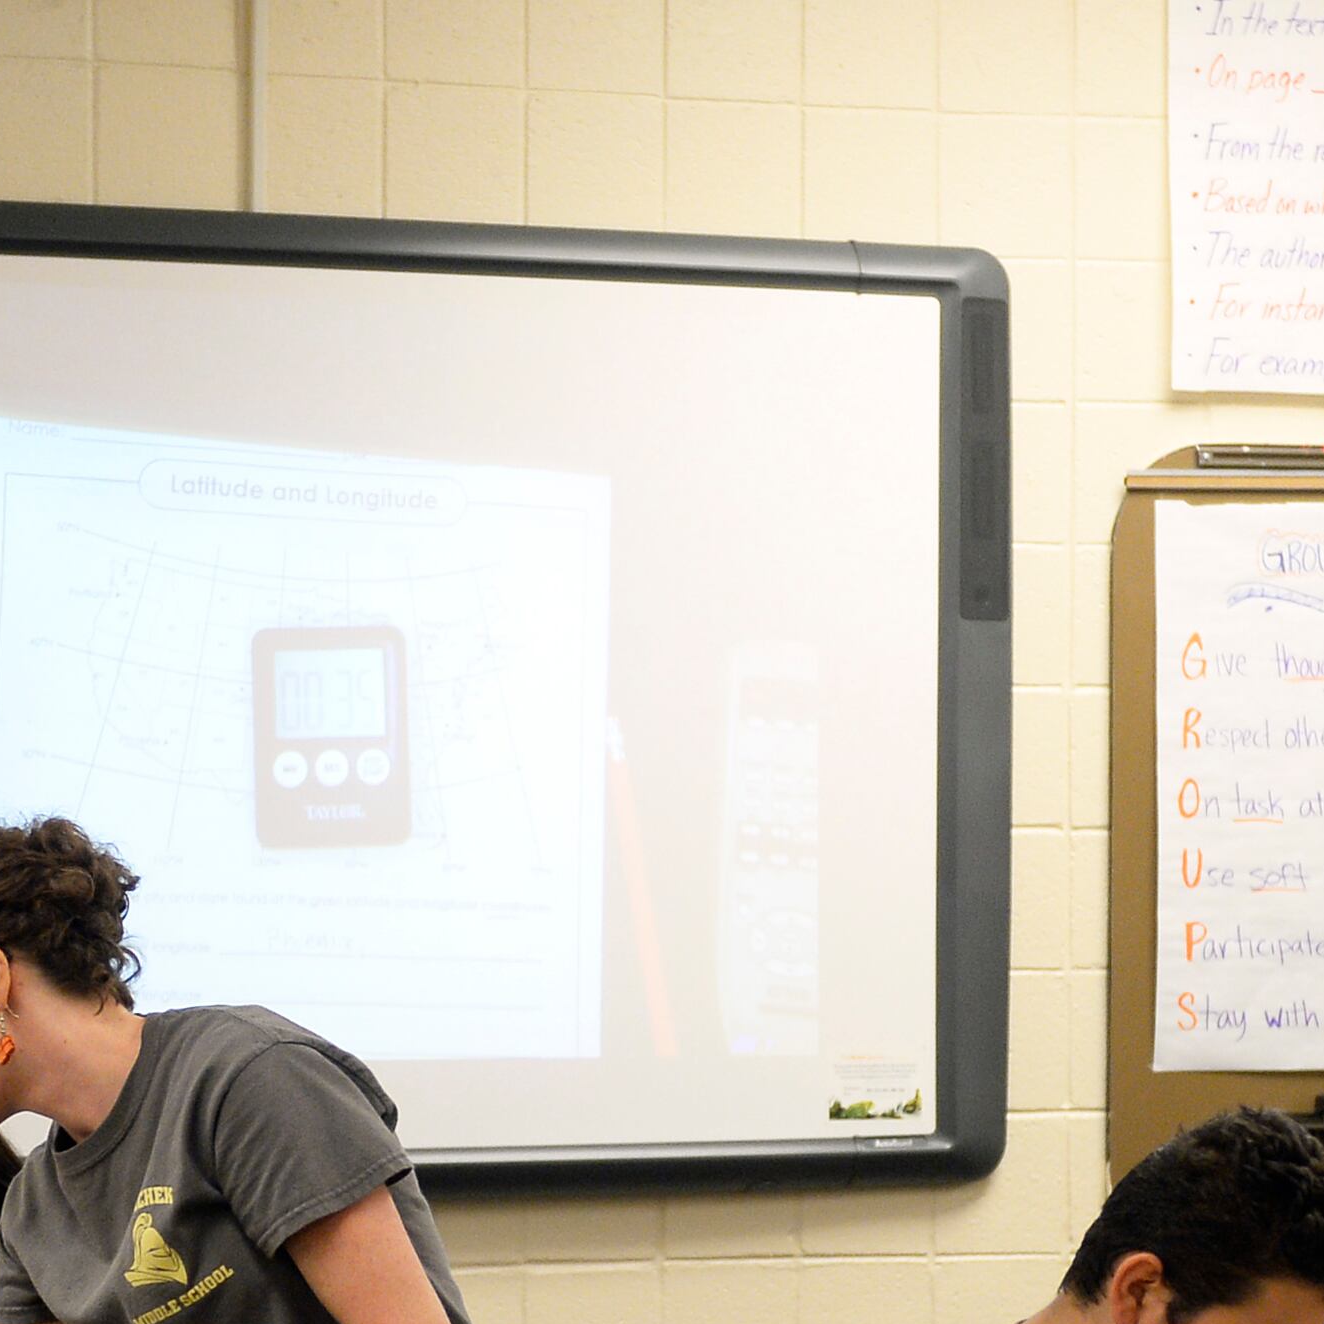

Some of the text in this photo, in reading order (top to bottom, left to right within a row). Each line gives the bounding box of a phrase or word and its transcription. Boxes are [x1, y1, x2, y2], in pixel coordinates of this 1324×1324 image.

[1243, 2, 1278, 36] the
[1208, 53, 1238, 90] On
[1247, 69, 1306, 103] page
[1204, 122, 1260, 161] From
[1268, 125, 1304, 162] the
[1203, 177, 1273, 214] Based
[1275, 196, 1297, 216] on
[1207, 230, 1251, 268] The
[1209, 282, 1251, 321] For
[1204, 337, 1249, 376] For
[170, 474, 438, 512] Latitude and Longitude
[1183, 707, 1270, 752] Respect
[1178, 778, 1221, 819] On
[1234, 782, 1284, 820] task
[1299, 792, 1323, 817] at
[1181, 848, 1235, 889] Use
[1250, 863, 1308, 890] soft
[1178, 991, 1246, 1042] Stay
[1265, 1001, 1320, 1030] with
[179, 1265, 234, 1307] SCHOOL
